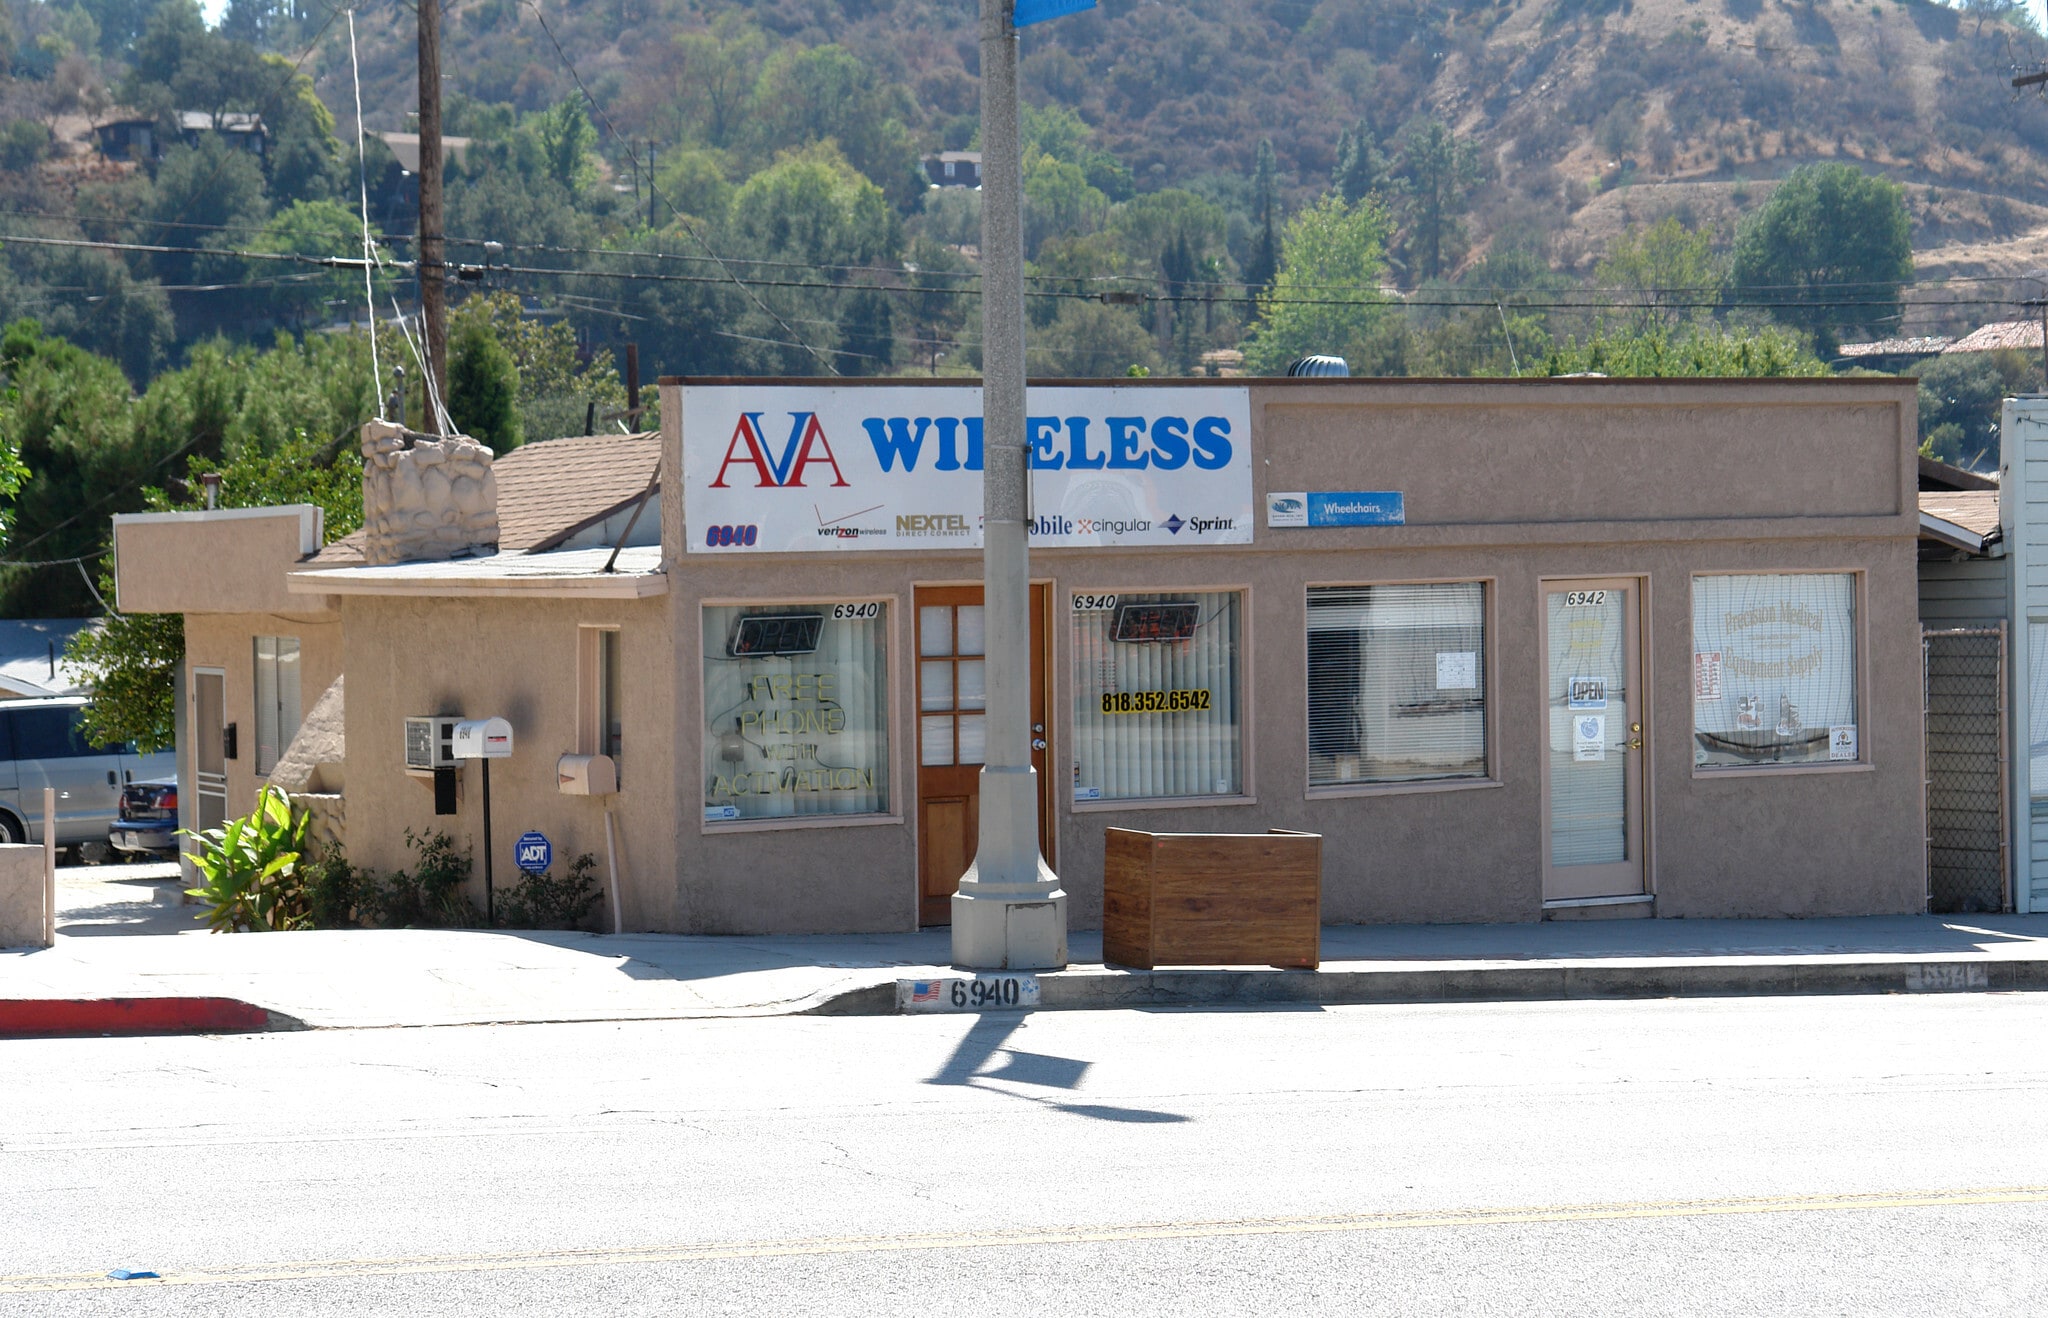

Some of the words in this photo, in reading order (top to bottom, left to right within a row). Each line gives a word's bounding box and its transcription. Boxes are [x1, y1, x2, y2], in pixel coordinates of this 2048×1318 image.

[708, 412, 851, 487] AVA
[1323, 502, 1381, 515] Wheelchairs
[817, 525, 859, 538] verizon
[859, 526, 887, 536] wireless
[896, 514, 970, 531] NEXTEL
[1091, 517, 1151, 535] cingular
[706, 524, 758, 547] 6940
[930, 529, 970, 537] CONNECT
[1074, 594, 1116, 609] 6940
[1568, 592, 1605, 606] 6942
[834, 602, 877, 618] 6940
[741, 620, 820, 650] OPEN
[752, 674, 836, 701] FREE
[1573, 682, 1604, 700] OPEN
[1101, 690, 1210, 714] 818.352.6542
[741, 708, 845, 735] PHONE
[711, 768, 874, 796] ACTIVATION
[520, 845, 547, 862] ADT
[951, 978, 1019, 1008] 6940
